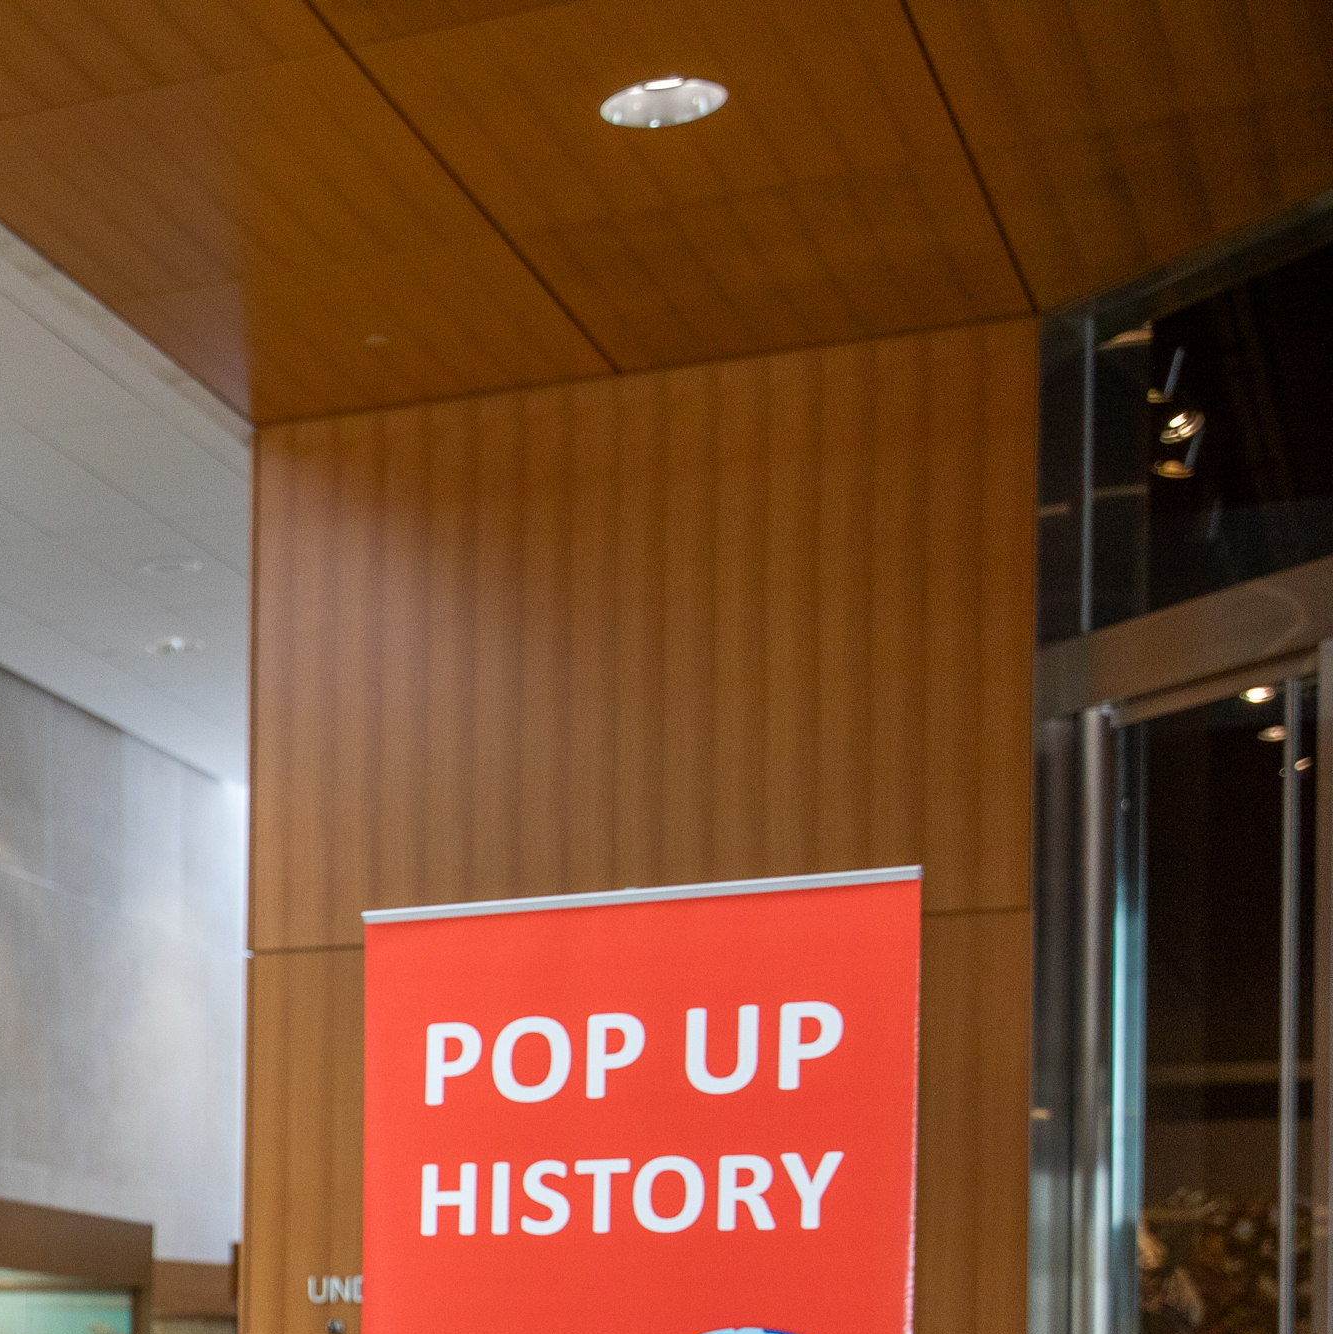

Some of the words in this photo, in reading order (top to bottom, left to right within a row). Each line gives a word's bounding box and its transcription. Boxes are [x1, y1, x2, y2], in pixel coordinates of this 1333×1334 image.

[425, 1012, 646, 1106] POP
[685, 1000, 844, 1096] UP
[420, 1151, 844, 1236] HISTORY
